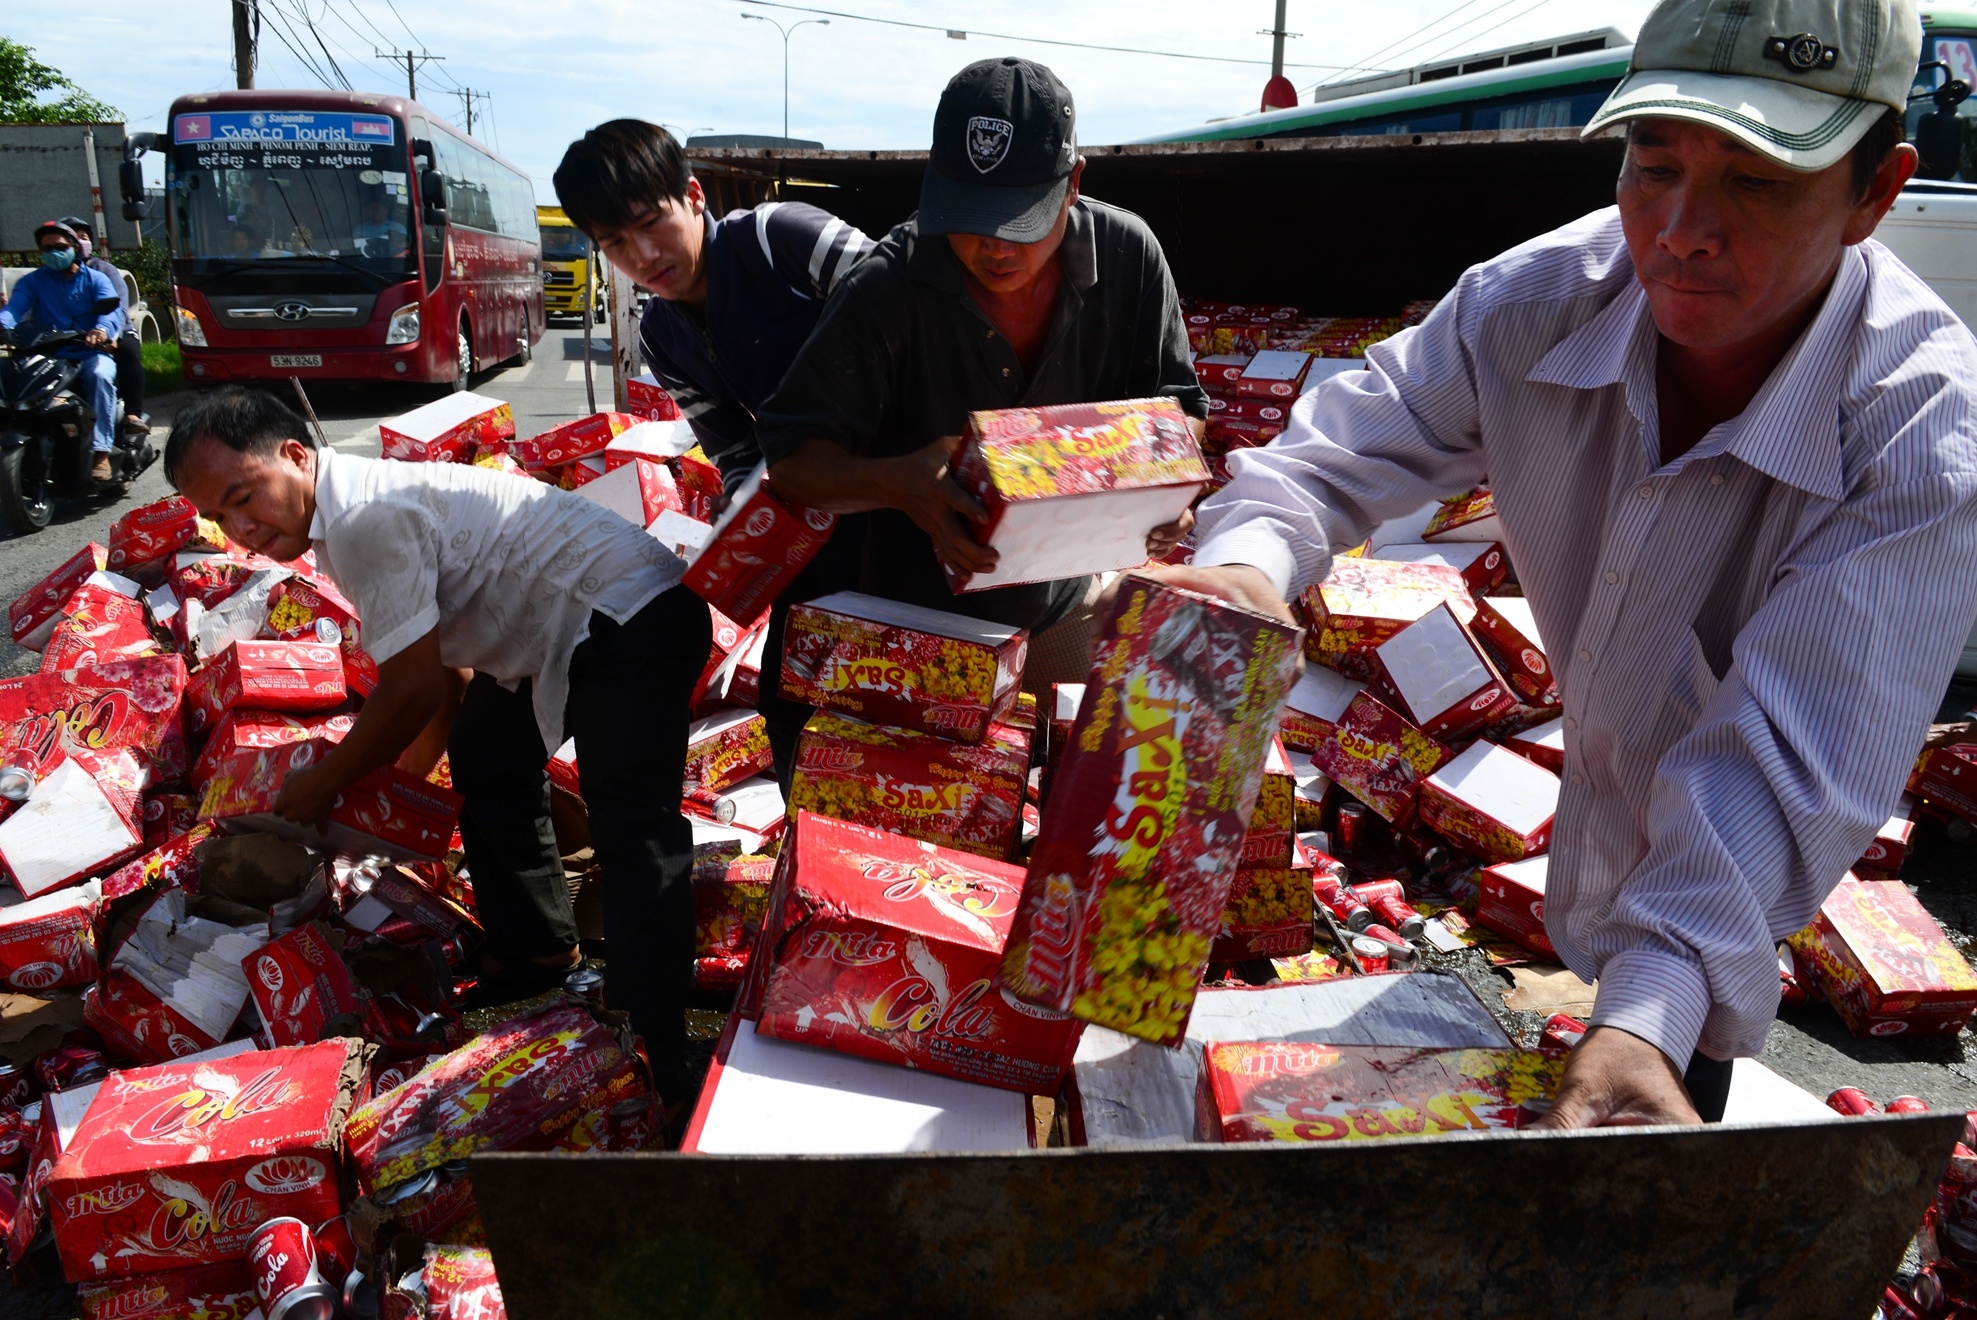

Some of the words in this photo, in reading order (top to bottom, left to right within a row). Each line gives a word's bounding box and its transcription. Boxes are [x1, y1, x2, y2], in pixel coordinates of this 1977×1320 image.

[268, 114, 315, 124] SaigonBus
[971, 120, 1010, 137] POLICE
[197, 143, 210, 151] HO
[211, 143, 227, 151] CHI
[229, 143, 253, 151] MINH
[259, 142, 292, 151] PHNOM
[294, 142, 318, 151] PENH
[324, 143, 346, 151] SIEM
[18, 690, 130, 769] Cola
[923, 707, 981, 731] Mita
[802, 745, 864, 771] Mita
[862, 859, 1022, 918] Cola
[803, 929, 896, 967] Mita
[867, 975, 992, 1038] Cola
[1040, 1010, 1064, 1020] VINH
[794, 1025, 809, 1033] UP
[1241, 1048, 1340, 1077] Mita
[129, 1065, 290, 1142] Cola
[249, 1138, 265, 1149] 12
[66, 1180, 147, 1219] Mita
[290, 1181, 311, 1192] VINH
[150, 1180, 254, 1251] Cola
[257, 1252, 289, 1301] Cola
